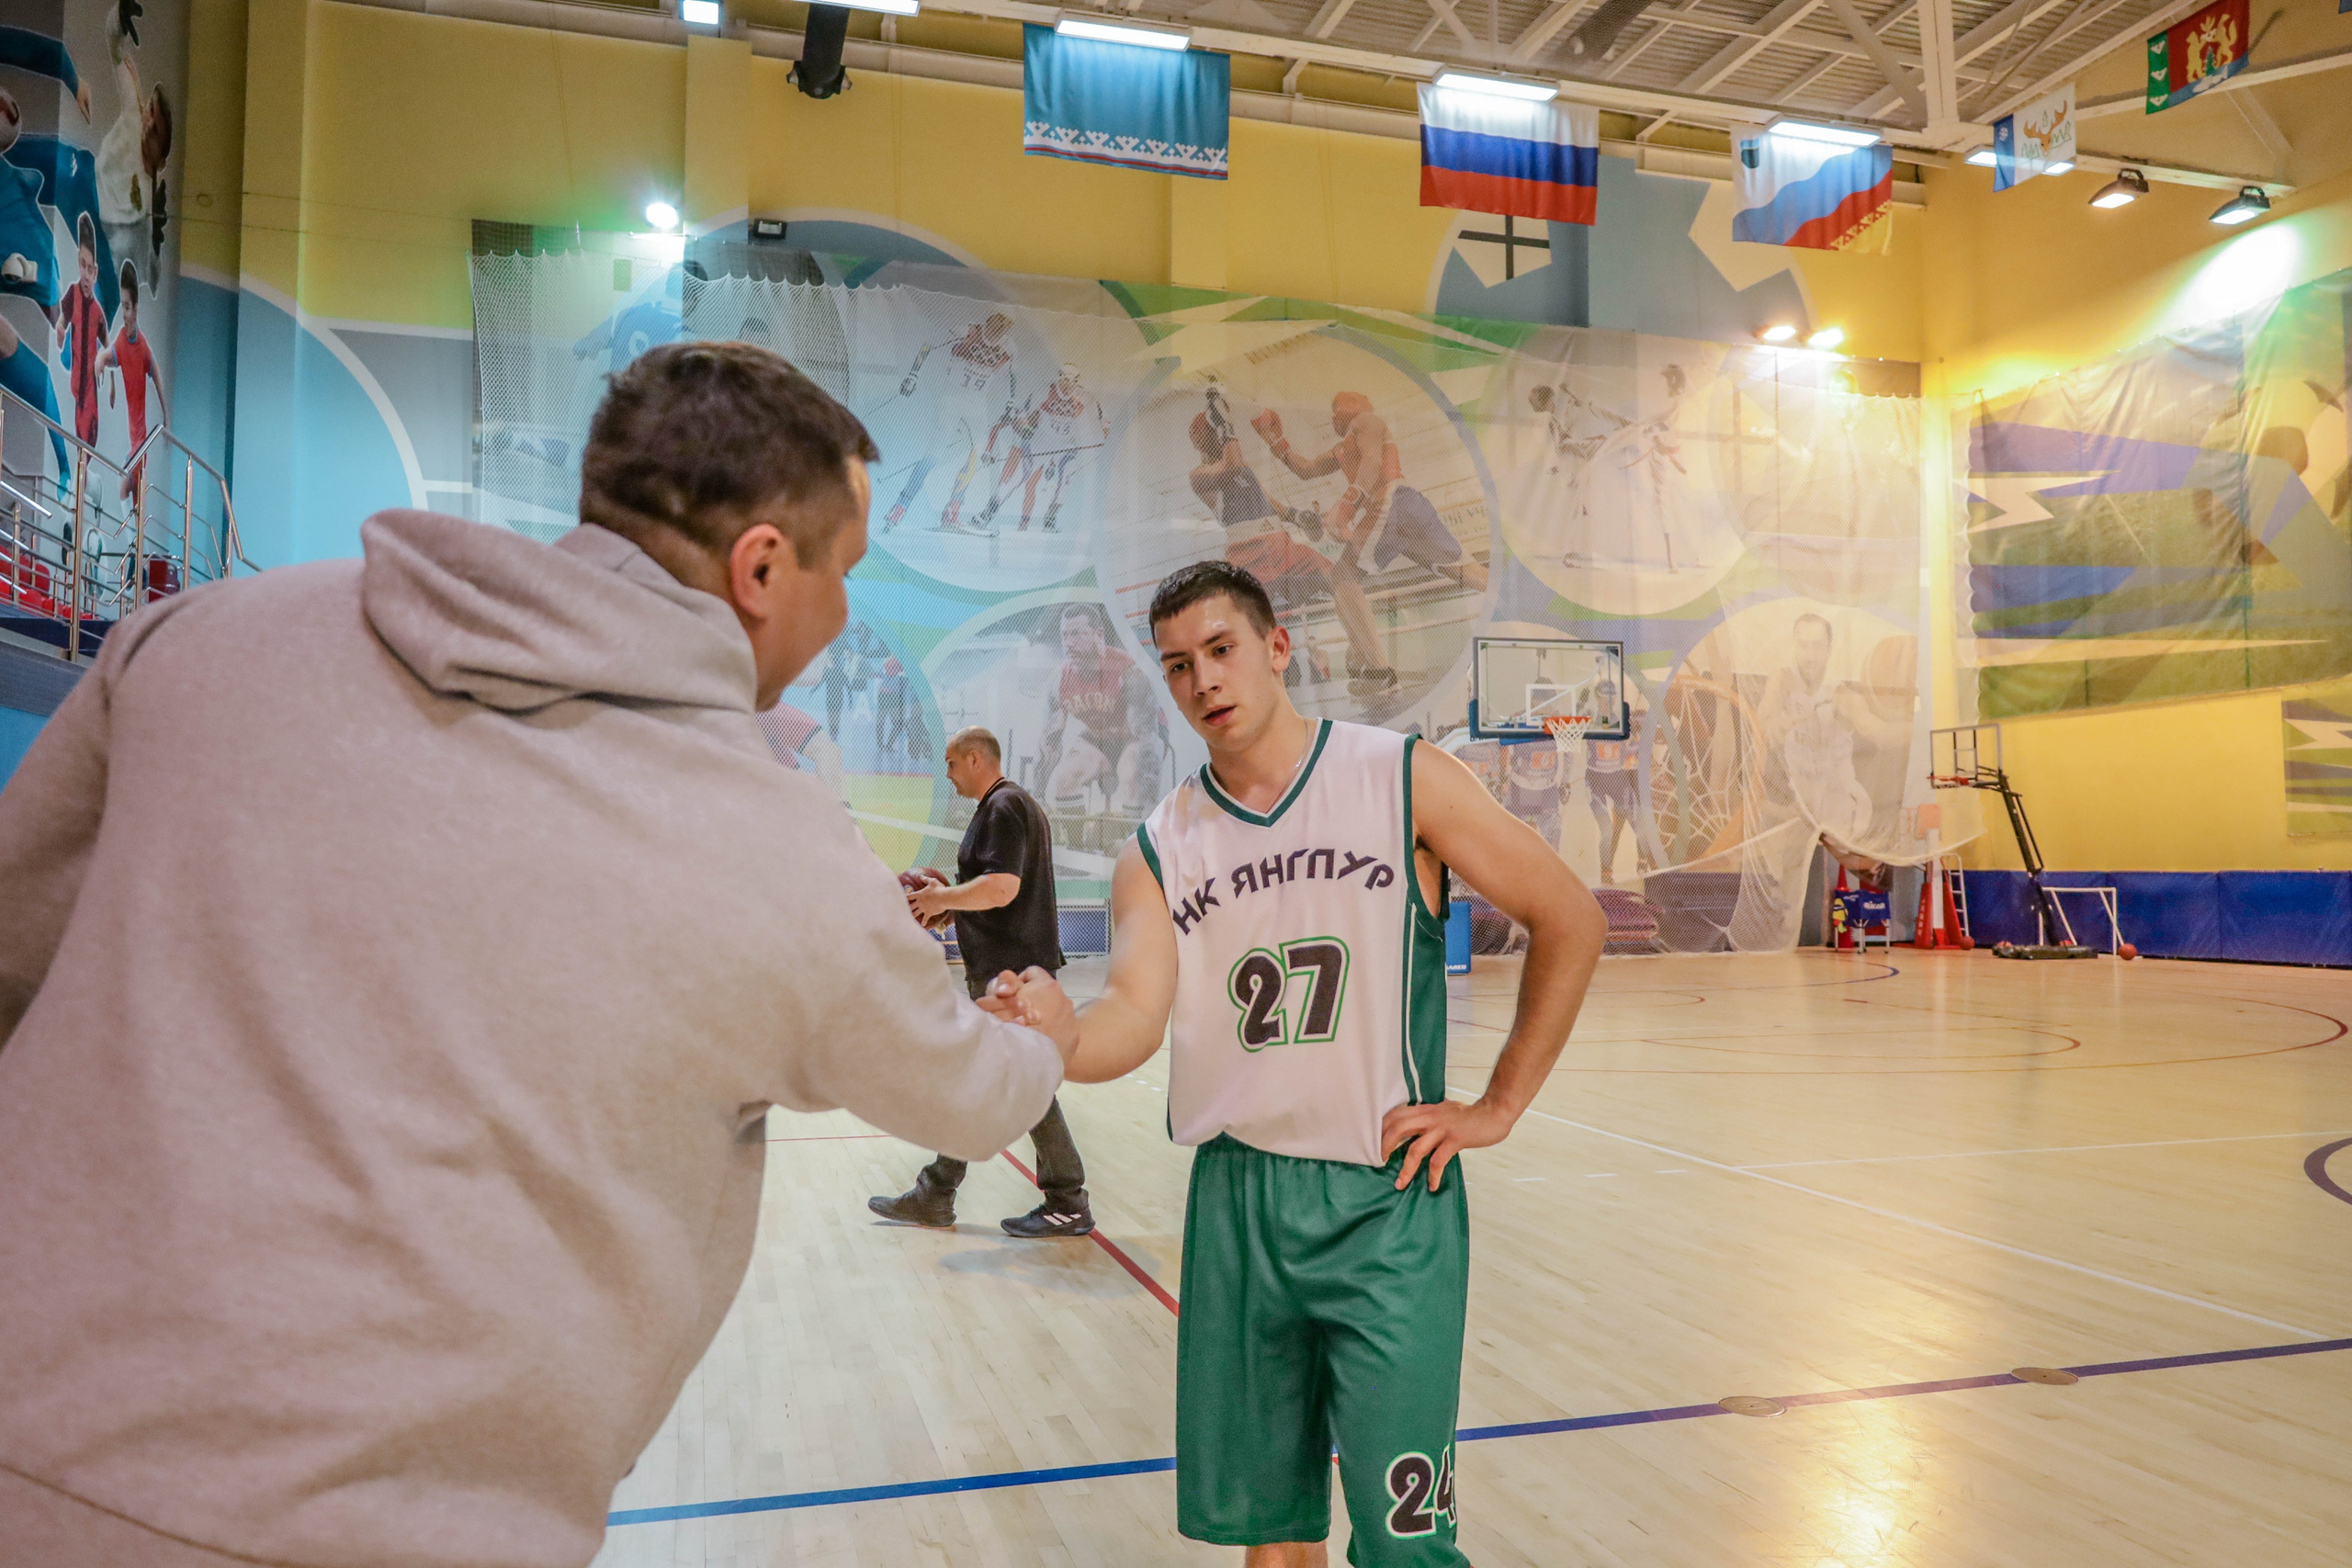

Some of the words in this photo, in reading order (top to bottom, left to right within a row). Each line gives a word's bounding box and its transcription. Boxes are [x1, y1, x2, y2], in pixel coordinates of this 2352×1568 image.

[1172, 876, 1221, 936] НК
[1230, 848, 1395, 899] ЯНГПУР
[1227, 935, 1350, 1053] 27
